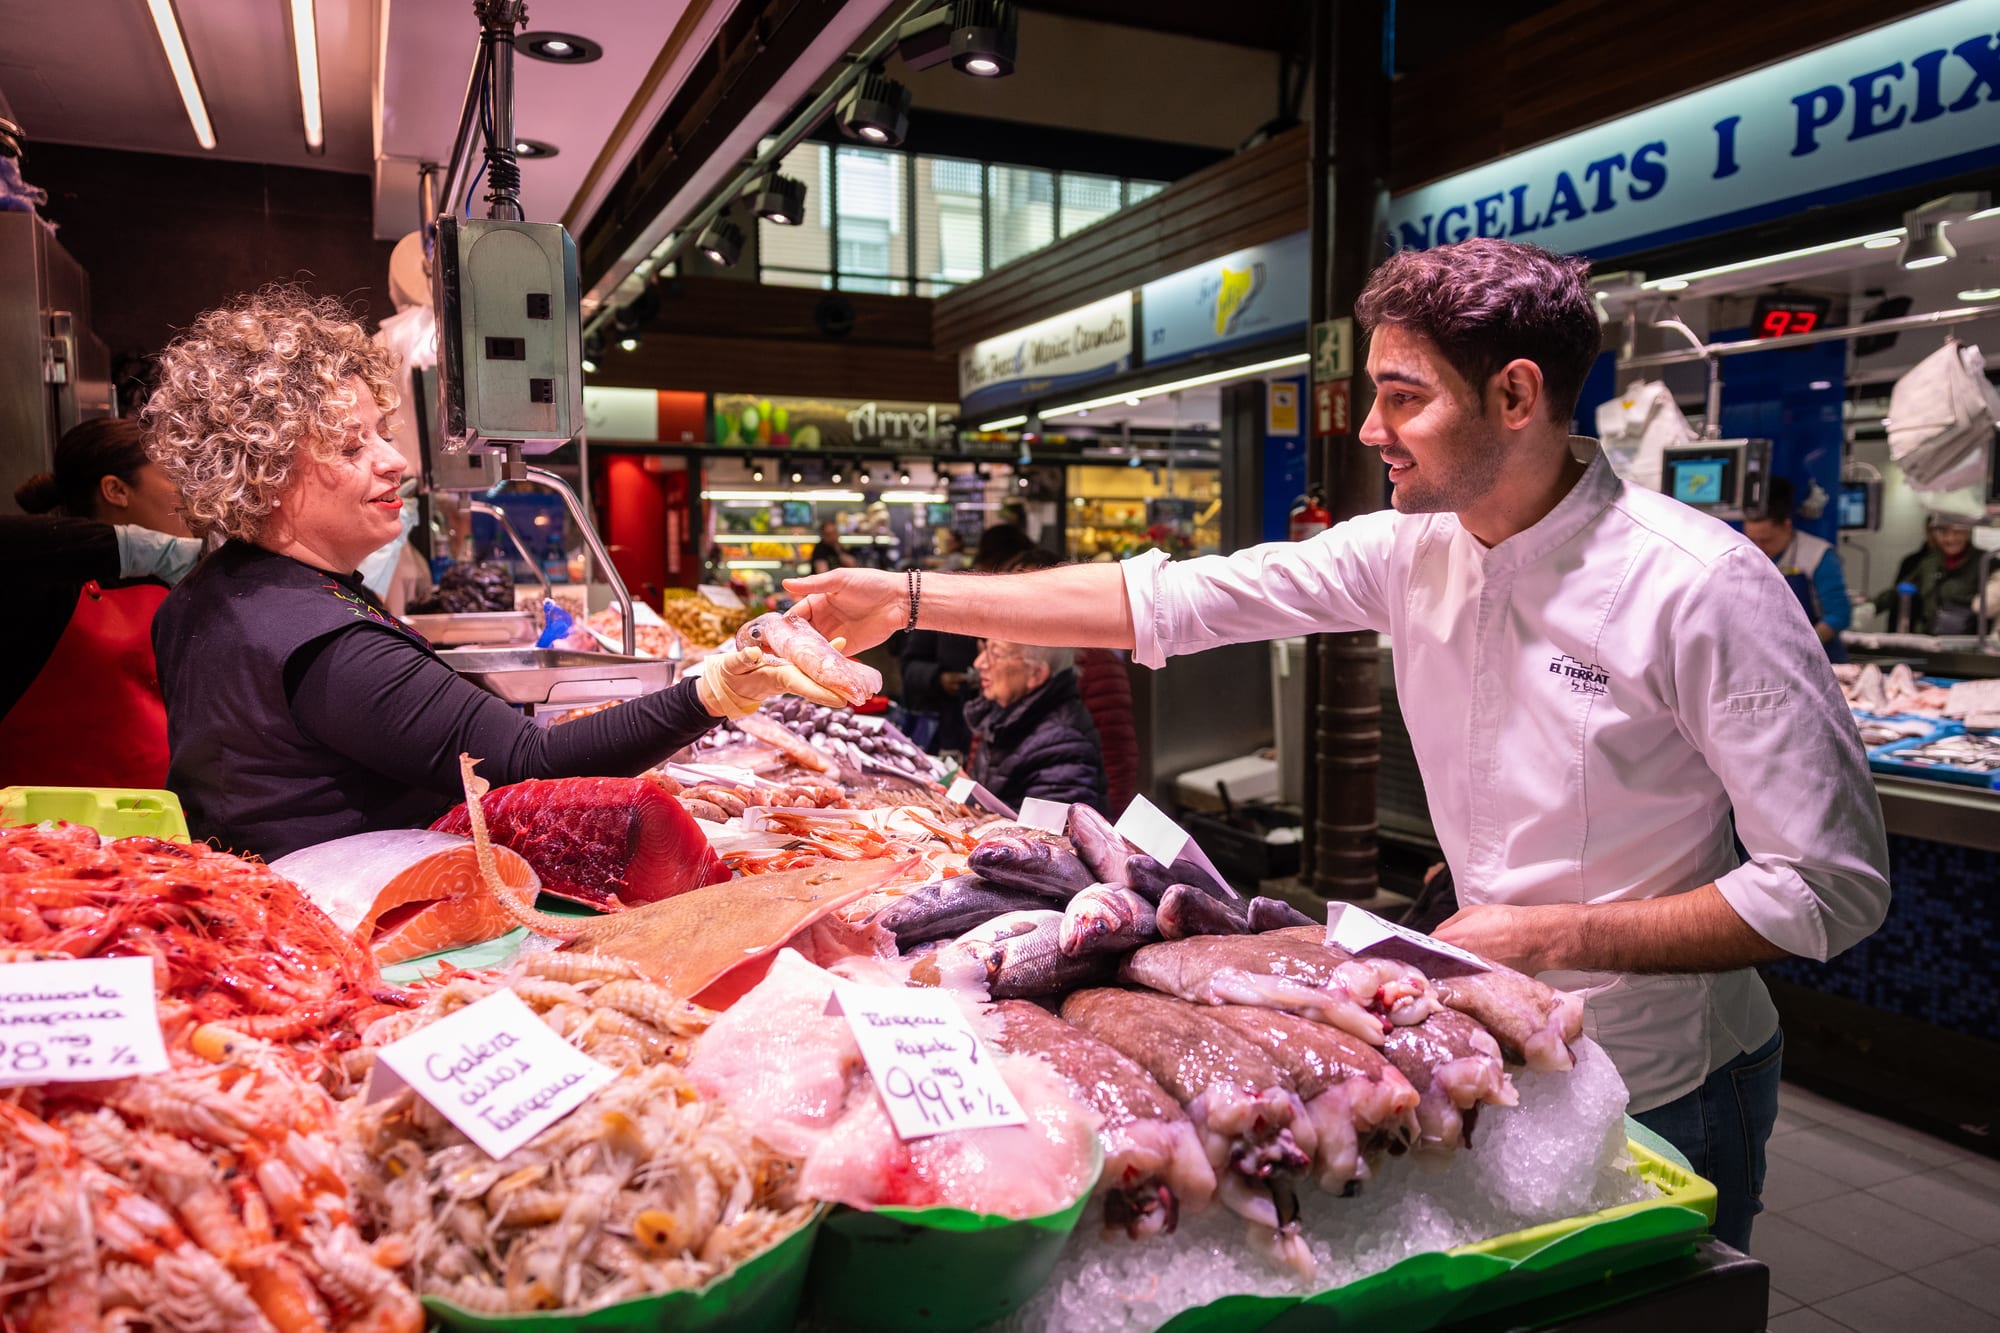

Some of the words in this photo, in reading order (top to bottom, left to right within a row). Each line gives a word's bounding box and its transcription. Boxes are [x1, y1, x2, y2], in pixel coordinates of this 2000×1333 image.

[1387, 141, 1667, 252] NGELATS
[1712, 115, 1741, 180] I
[1549, 662, 1562, 674] EL
[1564, 665, 1610, 685] TERRAT
